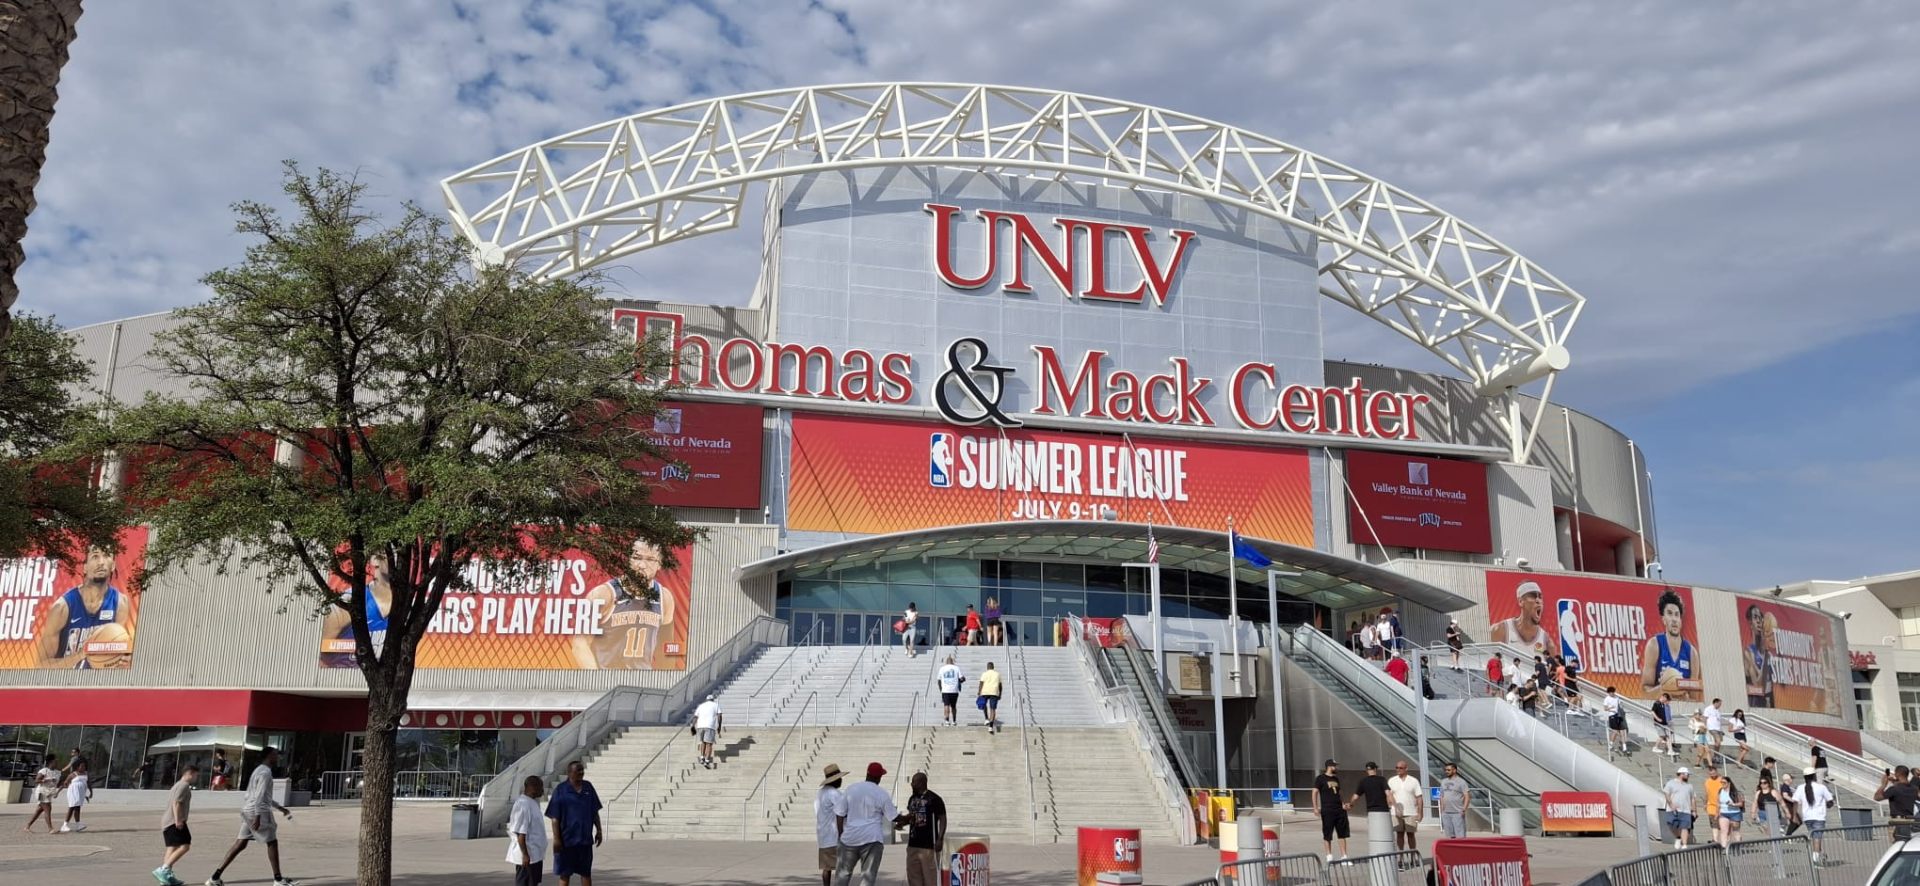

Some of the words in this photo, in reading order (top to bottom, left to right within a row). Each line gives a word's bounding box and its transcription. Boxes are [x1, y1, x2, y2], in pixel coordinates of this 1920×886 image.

[923, 203, 1196, 307] UNLV
[611, 308, 914, 404] Thomas
[931, 337, 1023, 427] &
[1031, 344, 1217, 427] Mack
[1227, 361, 1430, 440] Center
[647, 436, 670, 448] ank
[673, 436, 686, 447] of
[688, 437, 732, 449] Nevada
[959, 436, 1083, 496] SUMMER
[1089, 444, 1188, 502] LEAGUE
[1372, 483, 1398, 495] Valley
[1400, 485, 1423, 497] Bank
[1424, 487, 1434, 497] of
[1435, 488, 1467, 500] Nevada
[1012, 499, 1062, 520] JULY
[1419, 513, 1441, 528] UNLV
[0, 556, 58, 597] MMER
[0, 598, 39, 641] GUE
[426, 597, 476, 634] ARS
[480, 597, 540, 635] PLAY
[543, 598, 606, 636] HERE
[611, 611, 636, 628] NEW
[1585, 601, 1646, 640] SUMMER
[623, 627, 648, 658] 11
[1588, 637, 1641, 675] LEAGUE
[1553, 803, 1582, 819] SUMMER
[1583, 803, 1608, 819] LEAGUE
[1452, 863, 1492, 886] SUMMER
[1492, 860, 1524, 886] LEAGUE
